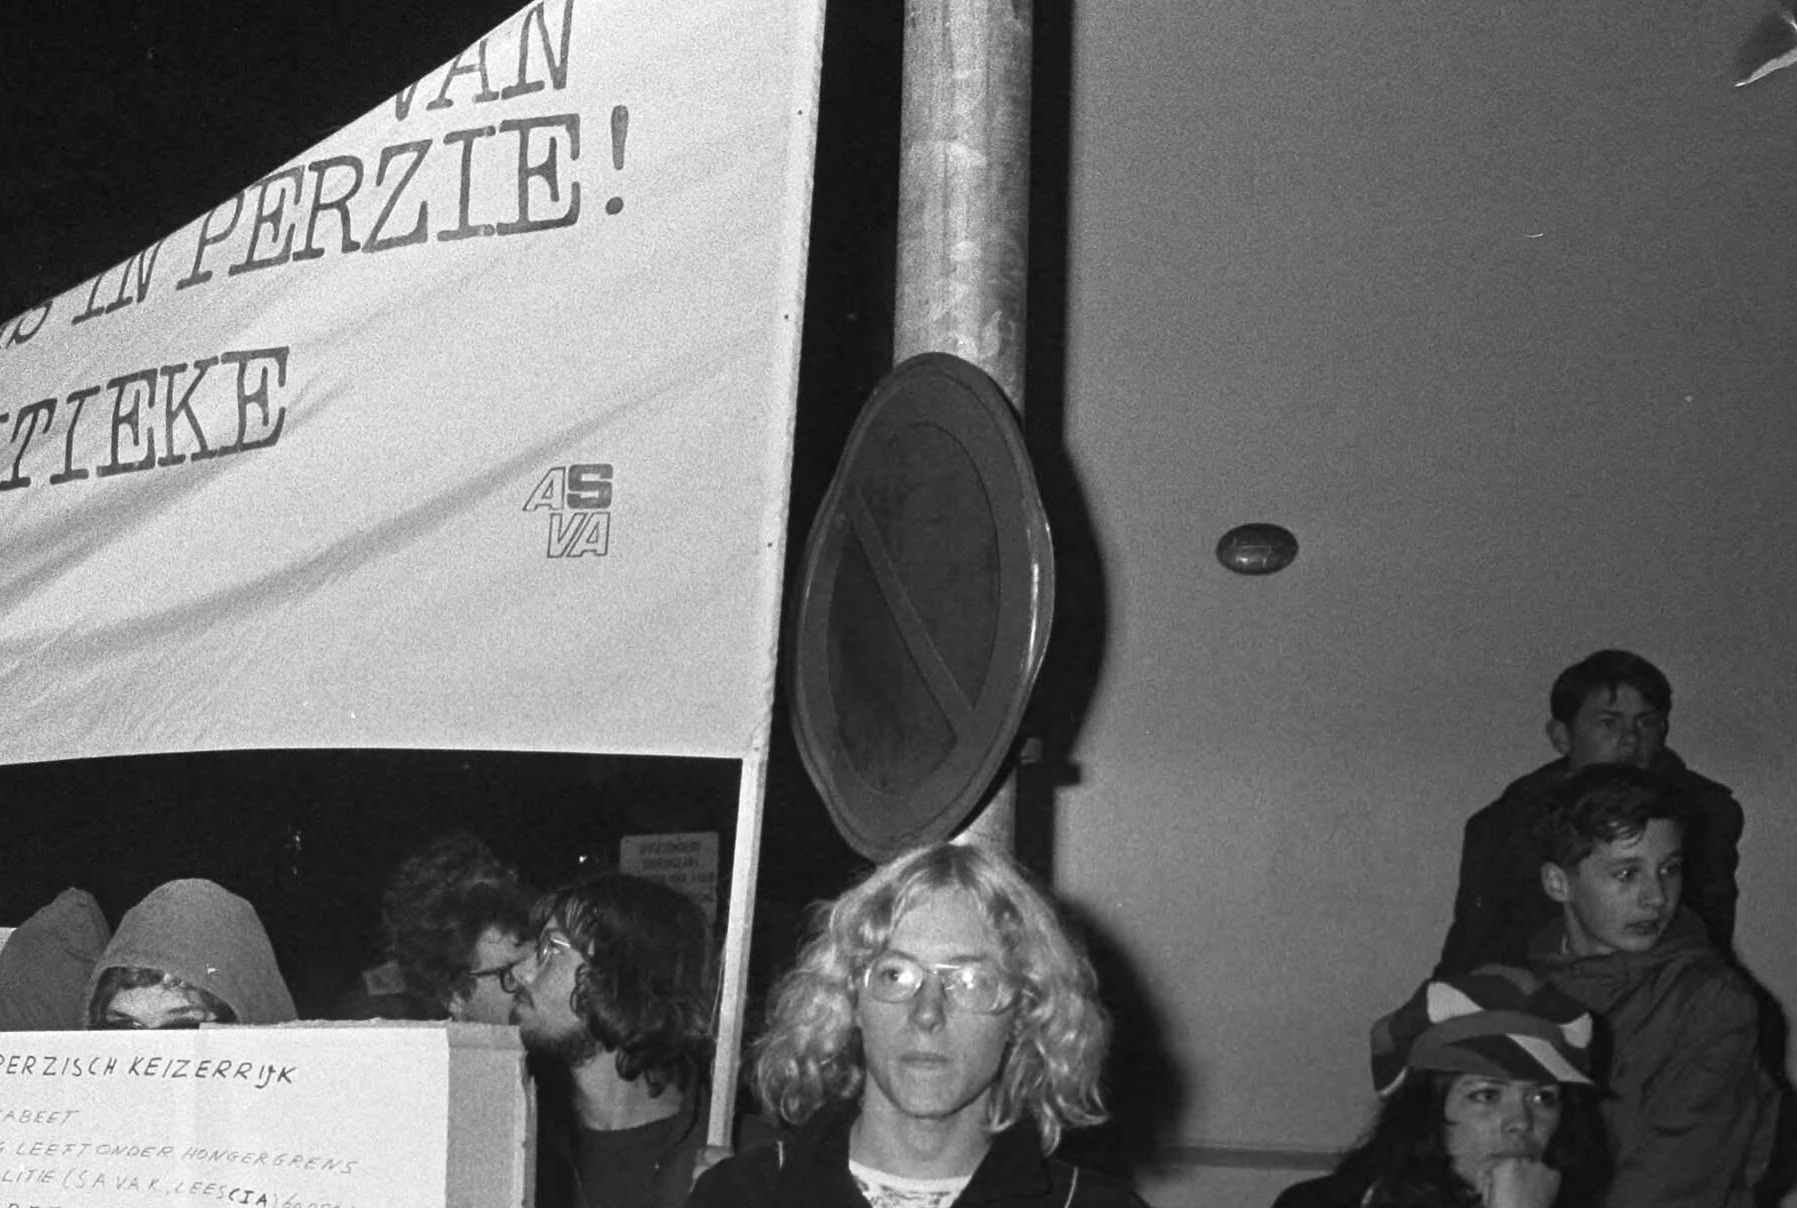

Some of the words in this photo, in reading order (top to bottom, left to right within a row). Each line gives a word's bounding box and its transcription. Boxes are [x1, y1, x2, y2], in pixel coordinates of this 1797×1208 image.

[175, 105, 629, 291] PERZIE!
[15, 1142, 90, 1157] LEEFT
[94, 1144, 175, 1160] ONDER
